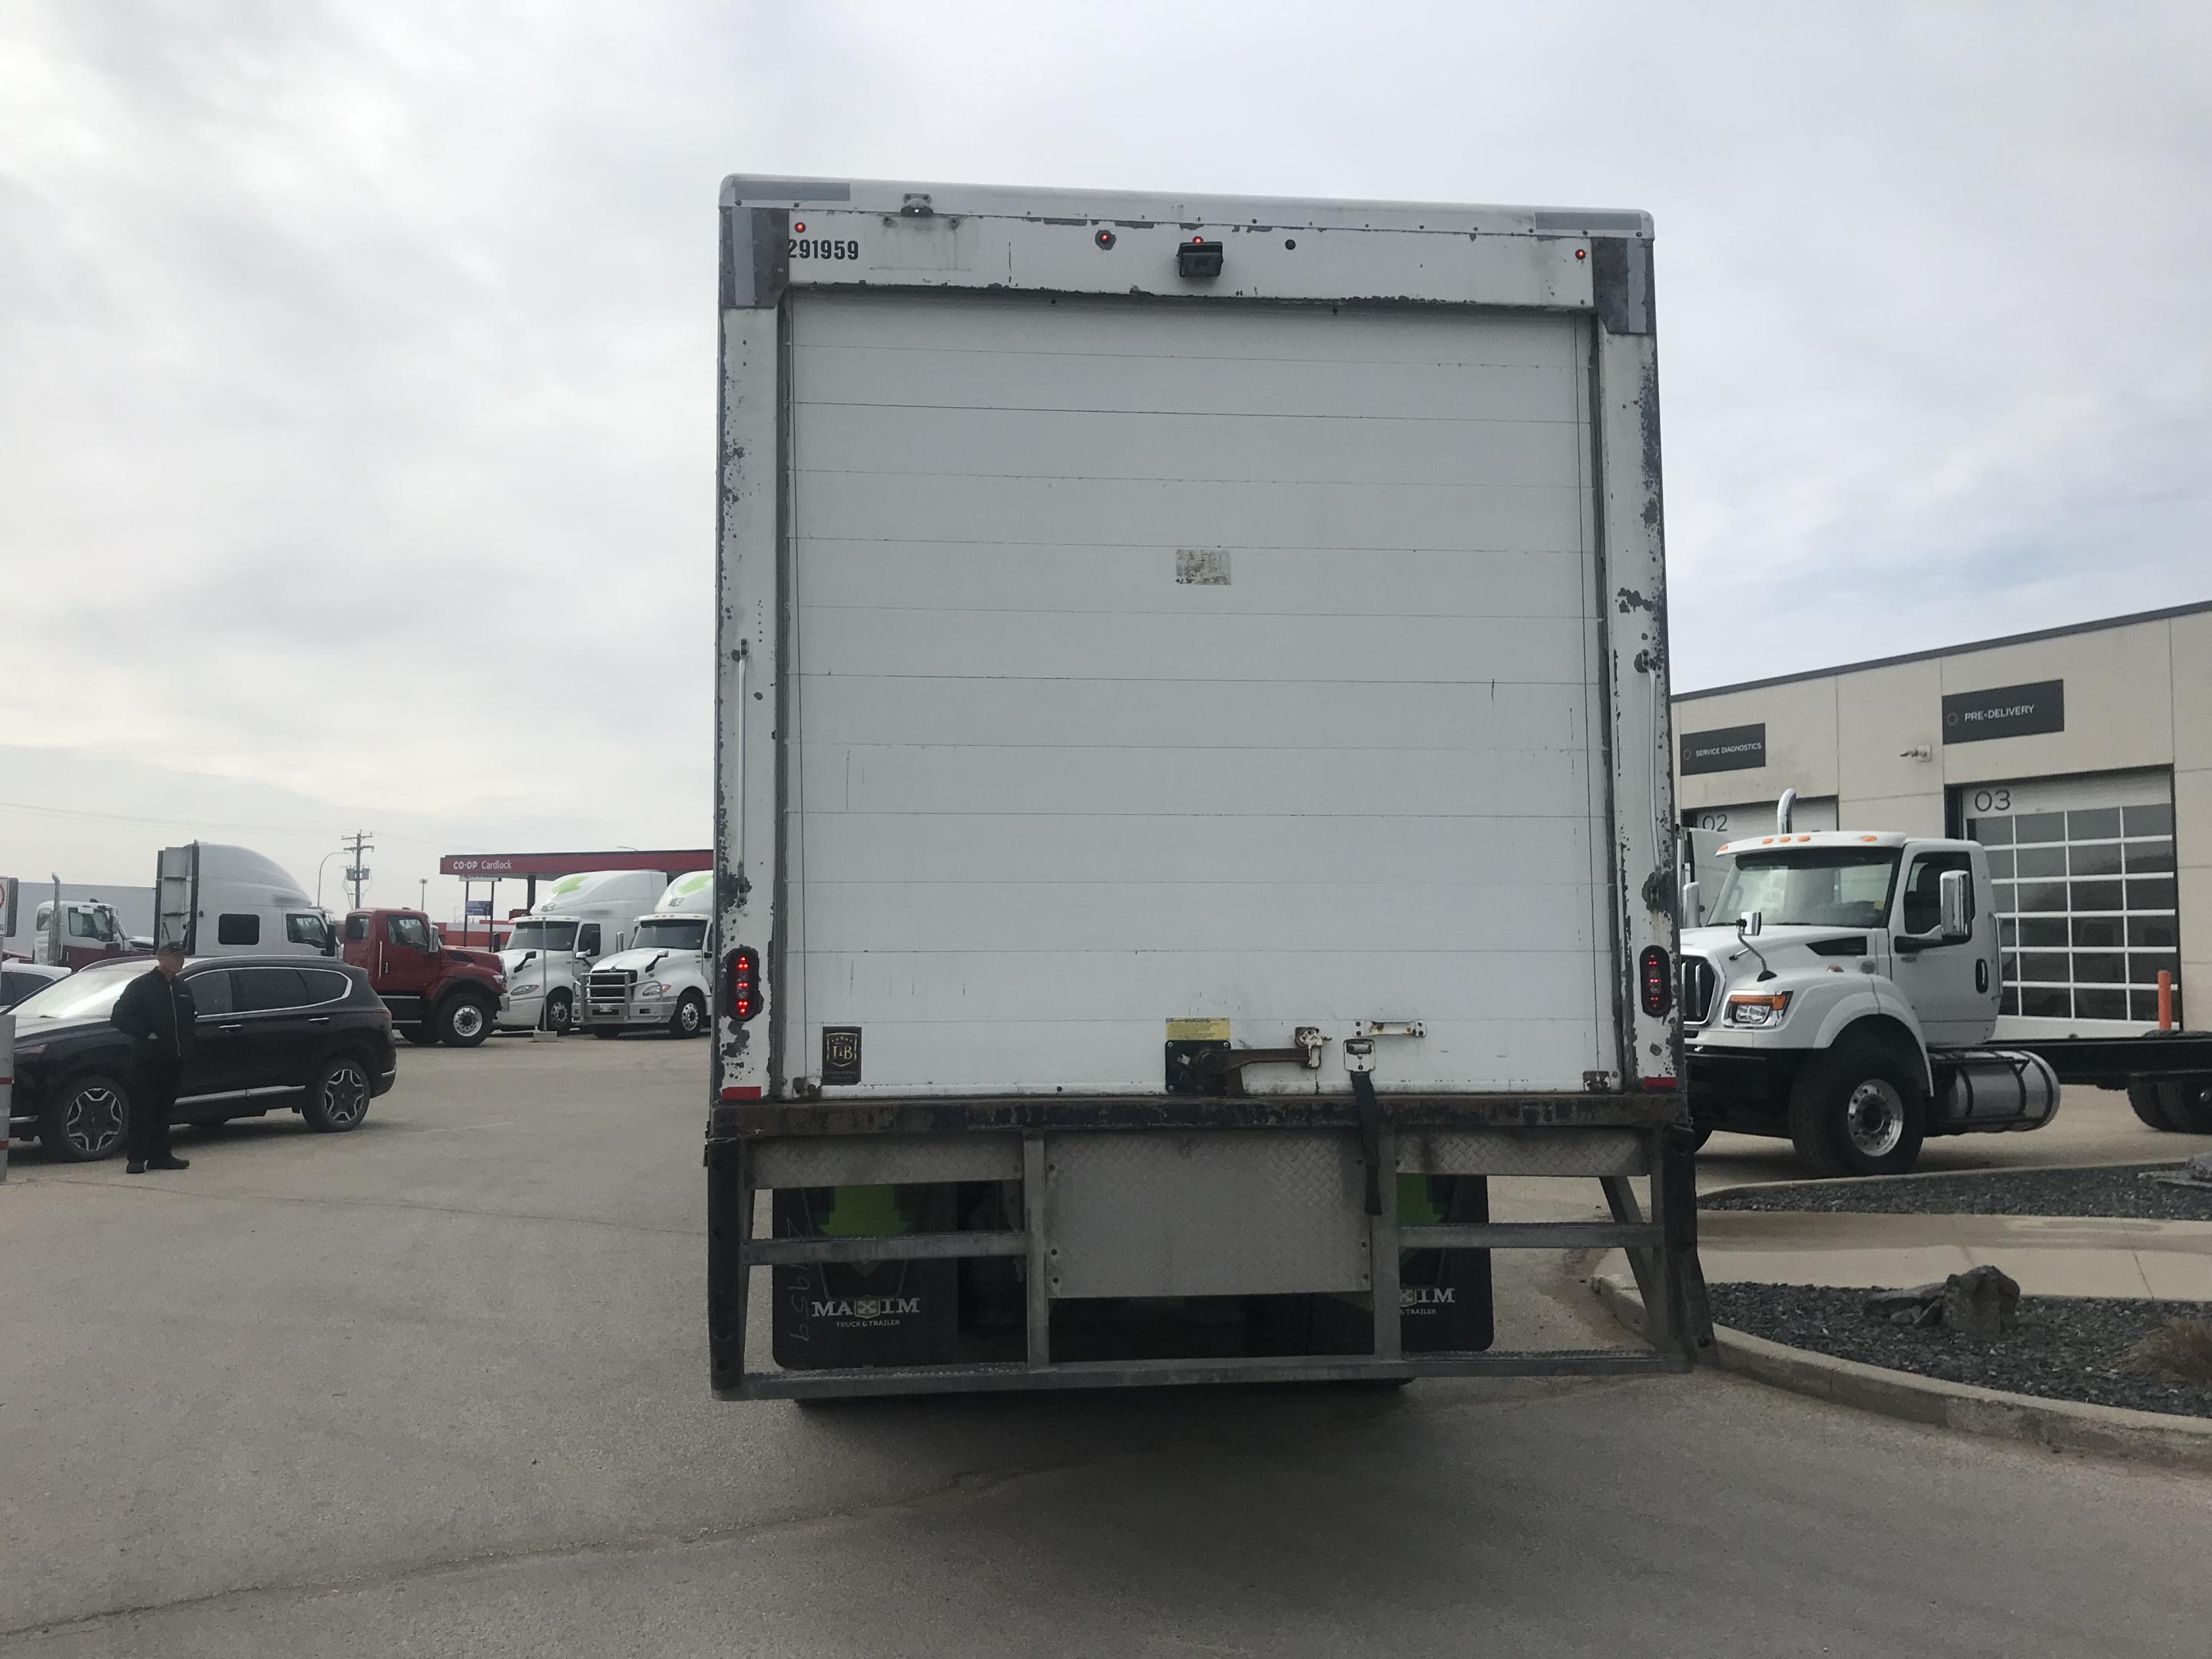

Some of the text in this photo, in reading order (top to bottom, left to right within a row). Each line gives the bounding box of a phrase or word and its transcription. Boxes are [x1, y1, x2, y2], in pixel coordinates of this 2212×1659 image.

[789, 239, 859, 260] 291959
[1965, 704, 2035, 722] PRE-DELIVERY
[1696, 742, 1762, 757] SERVICE DIAGNOSTICS
[1975, 789, 2011, 813] 03
[1702, 814, 1728, 833] 02
[482, 860, 512, 869] Cardlock
[811, 1296, 920, 1318] MAXIM
